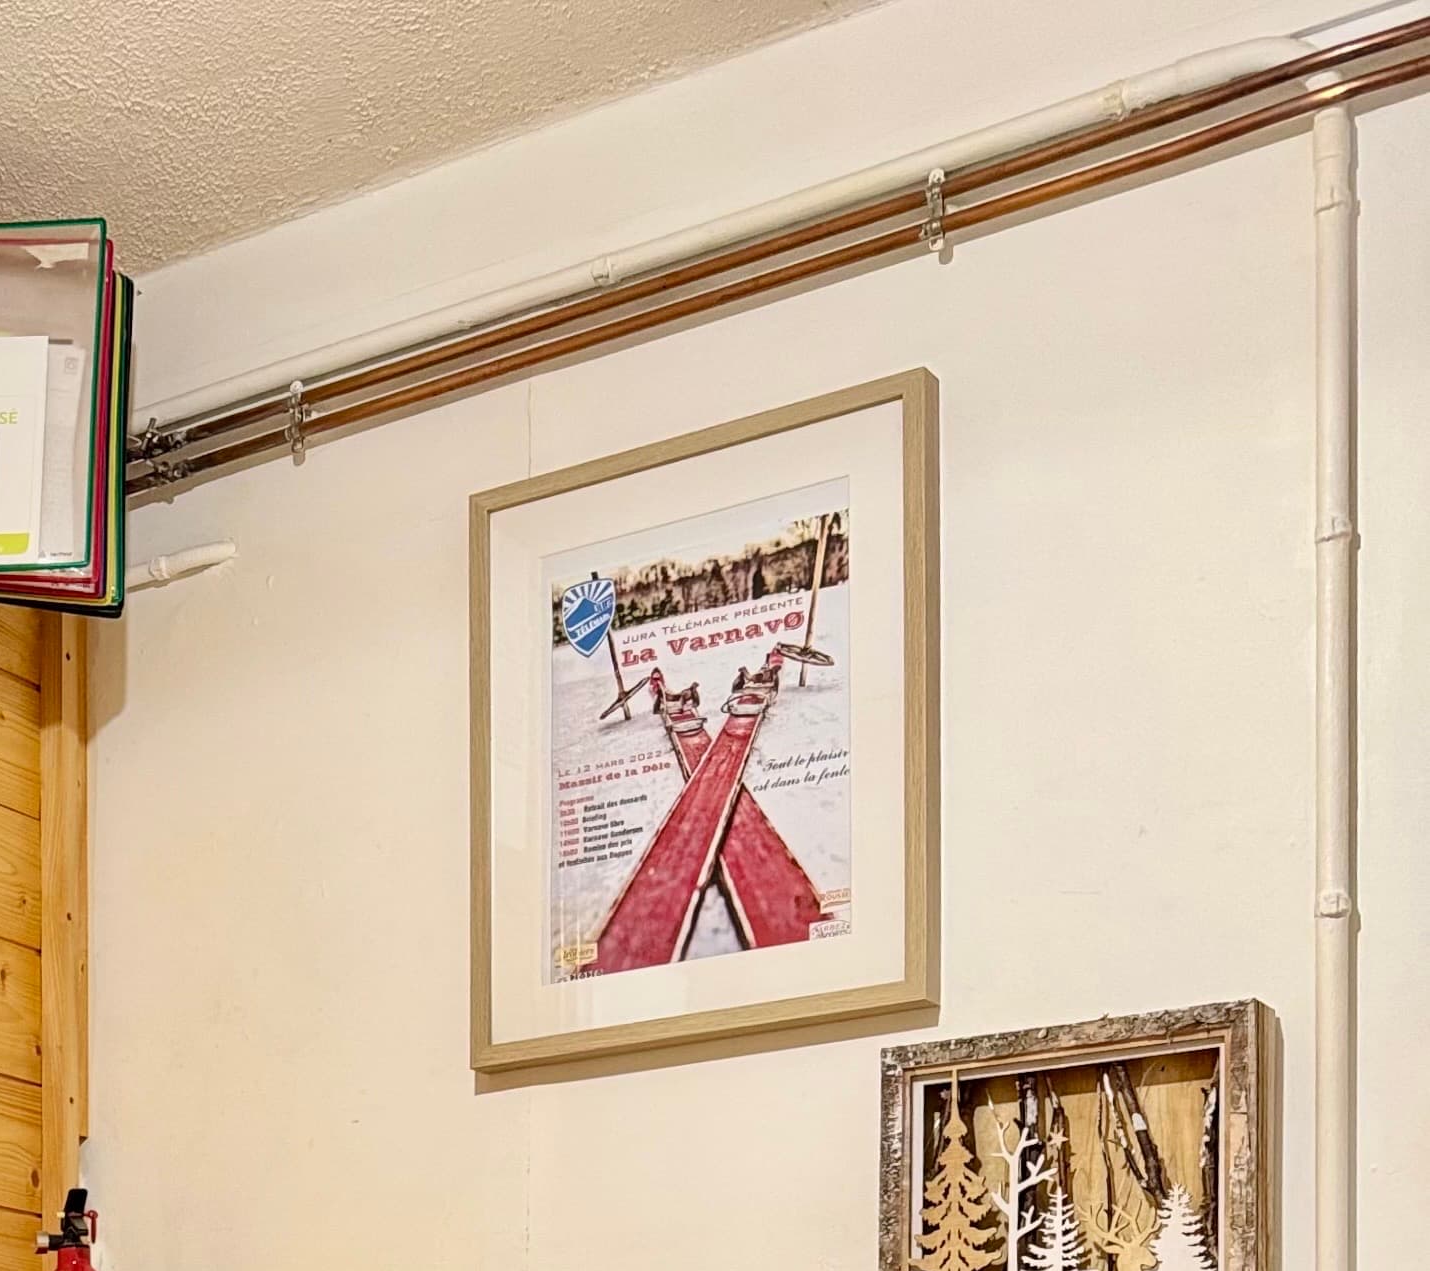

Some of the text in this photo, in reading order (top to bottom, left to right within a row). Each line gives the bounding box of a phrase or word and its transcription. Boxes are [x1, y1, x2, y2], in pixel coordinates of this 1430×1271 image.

[623, 597, 803, 645] JURA TÉLÉMARK PRÉSENTE
[621, 647, 658, 667] La
[596, 759, 624, 769] MARS
[630, 750, 662, 763] 2022
[795, 754, 805, 766] le
[805, 749, 849, 768] plaisir
[559, 762, 671, 790] Massif de la Dôle
[753, 779, 770, 792] est
[771, 776, 800, 789] dans
[804, 770, 815, 782] la
